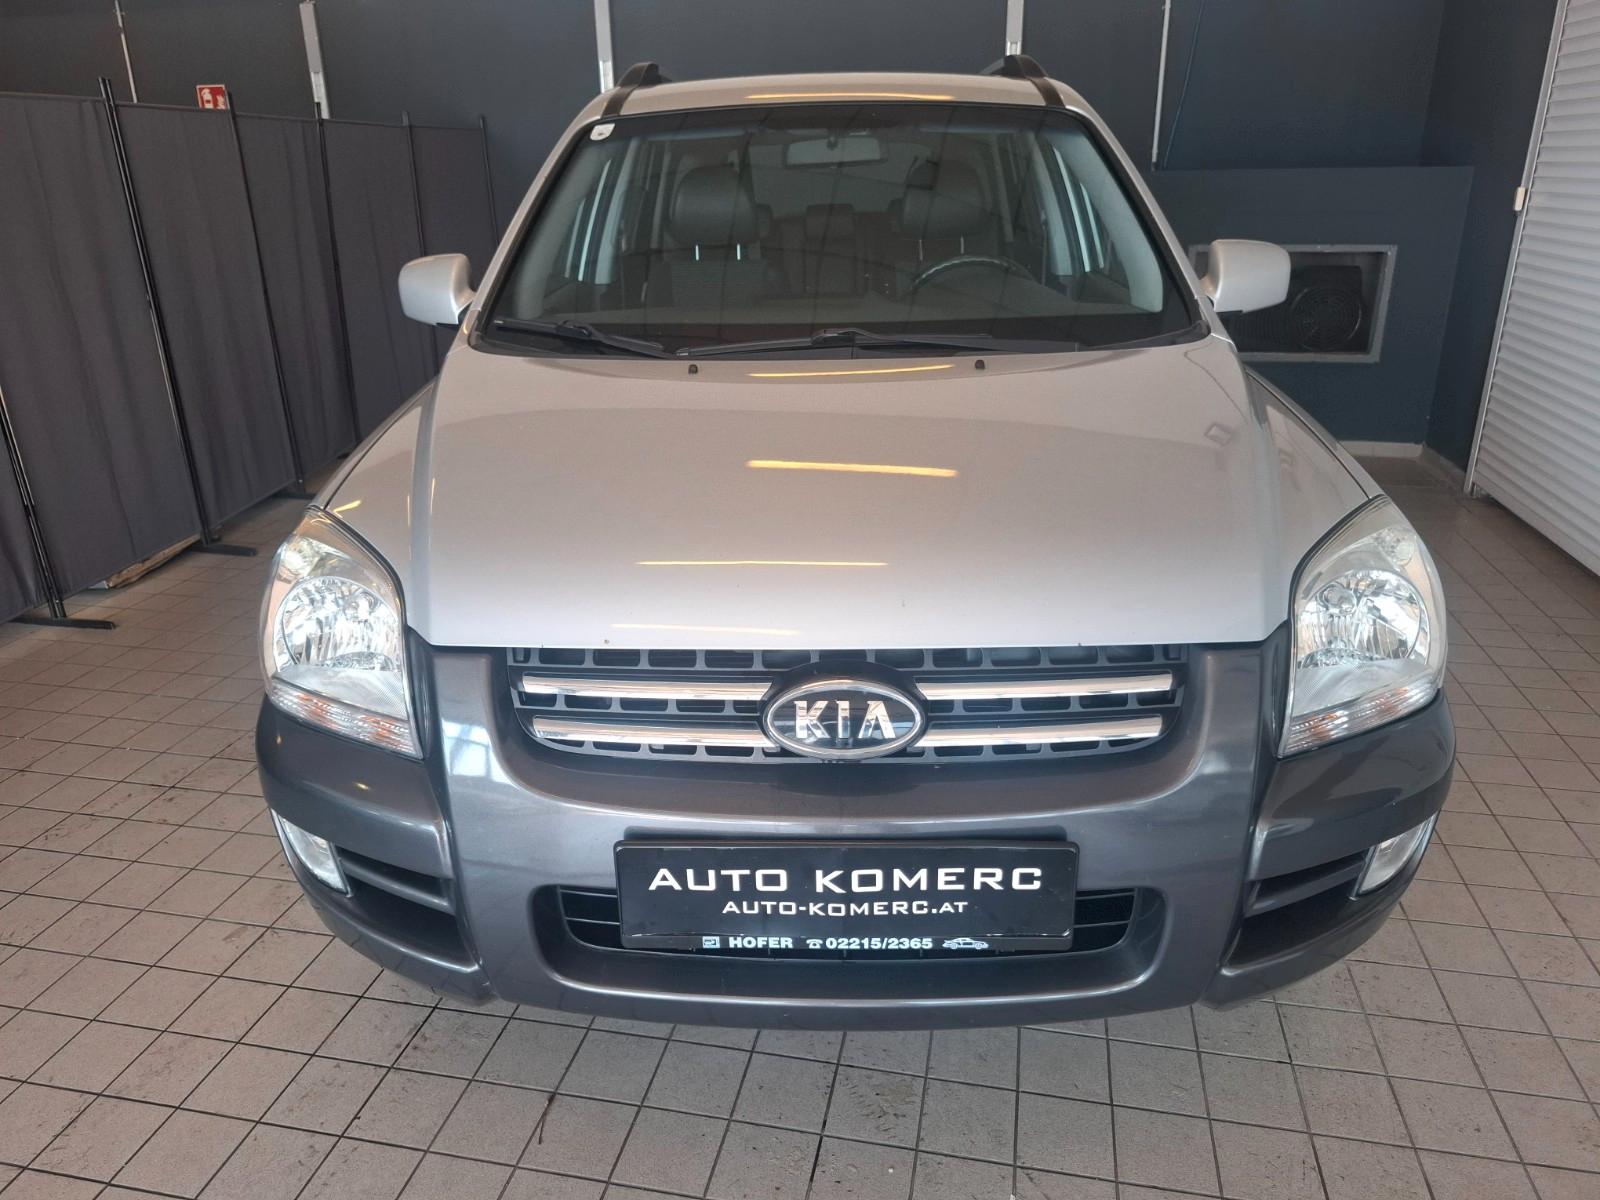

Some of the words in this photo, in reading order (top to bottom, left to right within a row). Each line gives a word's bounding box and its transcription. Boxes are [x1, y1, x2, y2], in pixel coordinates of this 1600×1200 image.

[794, 700, 896, 739] KIA
[648, 867, 789, 892] AUTO
[815, 867, 1042, 894] KOMERC
[721, 900, 969, 917] AUTO-KOMERC.AT
[728, 937, 794, 949] HOFER
[825, 937, 934, 950] 02215/2365
